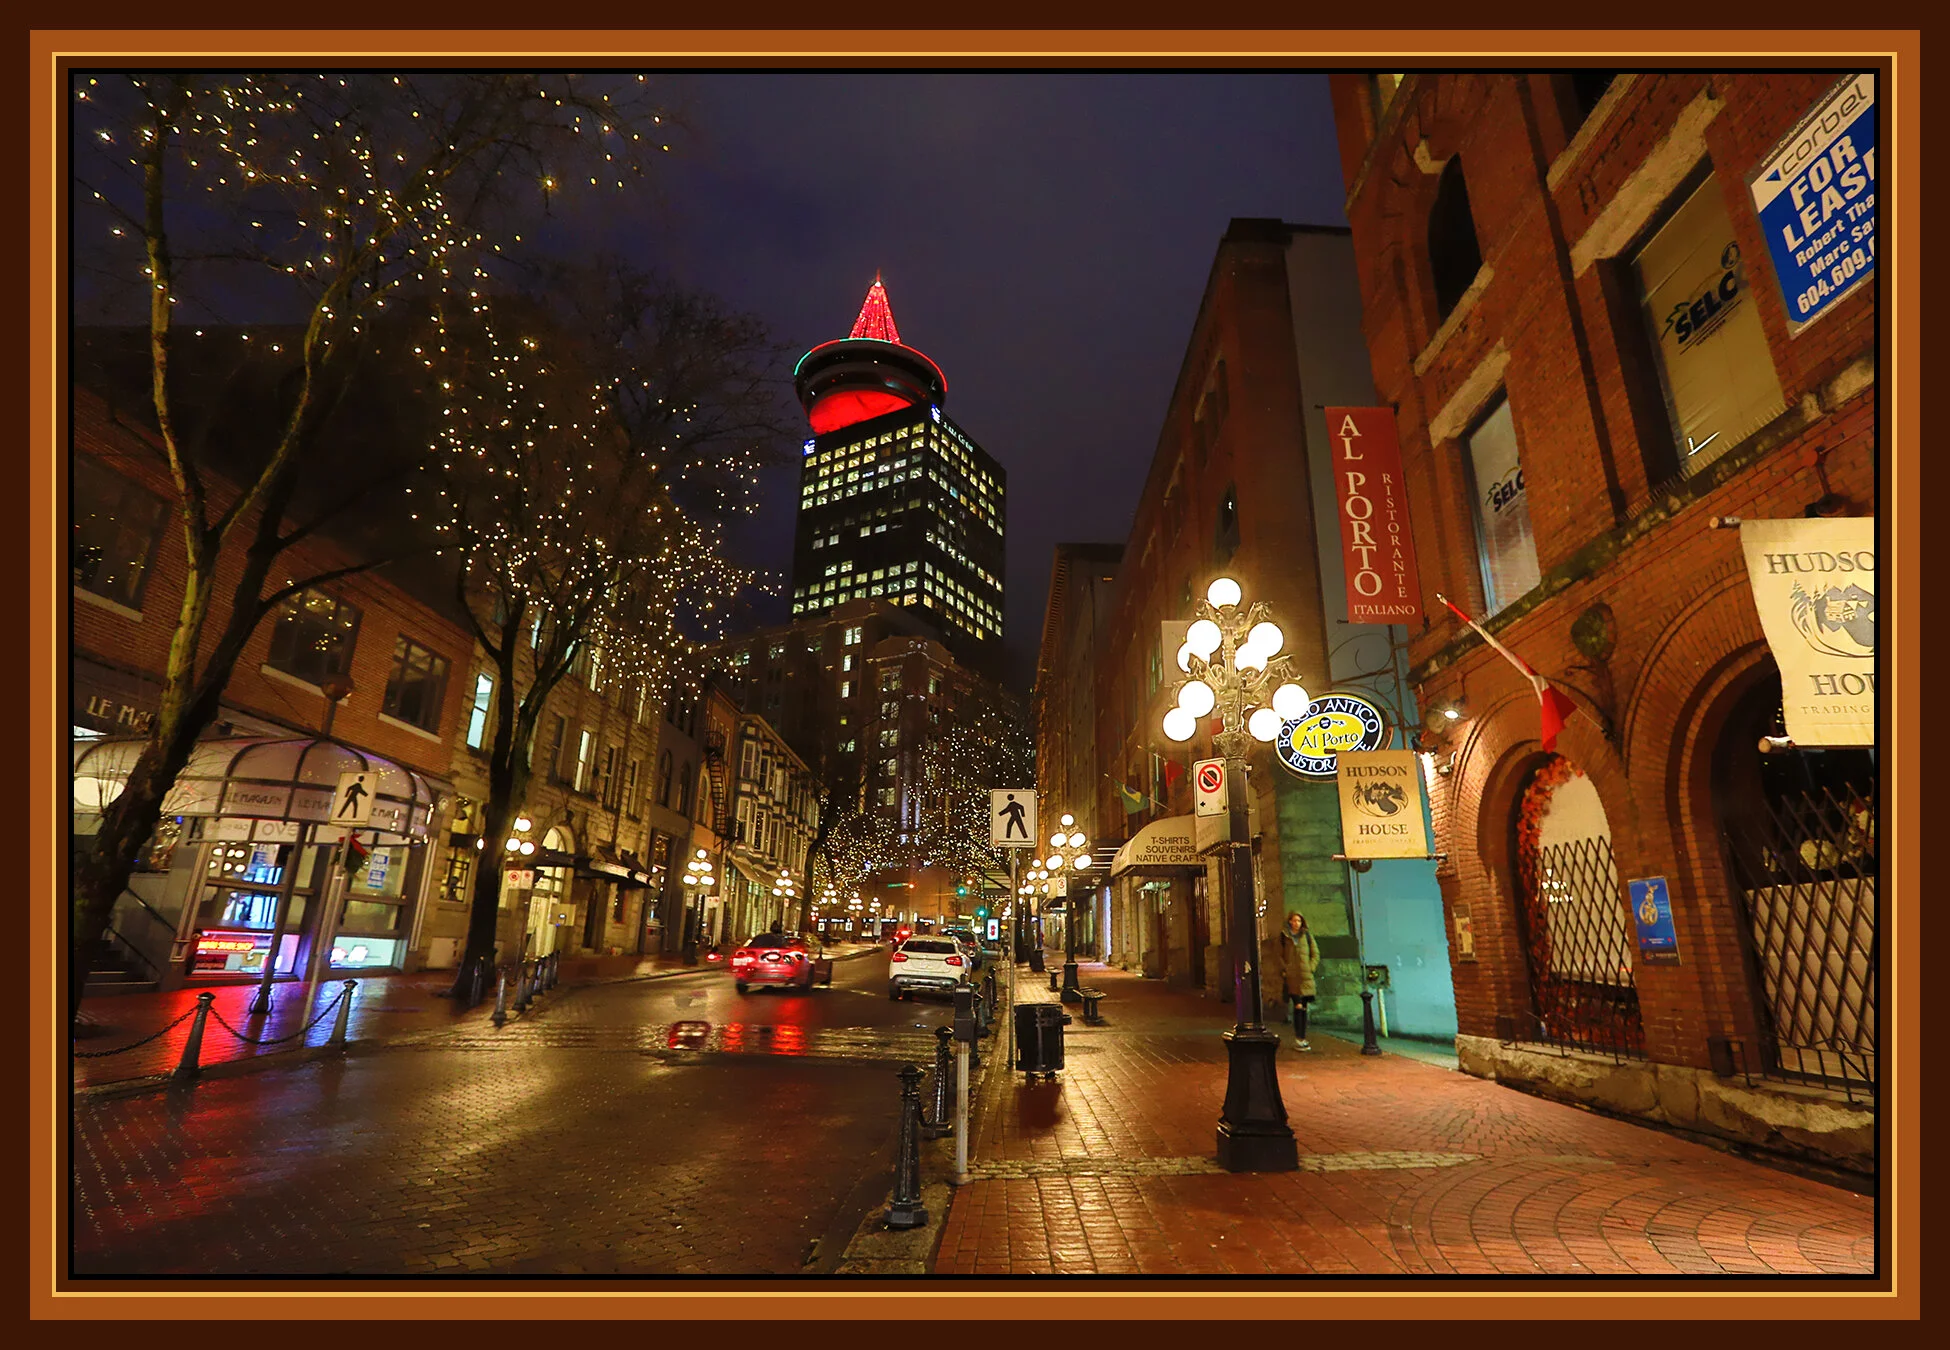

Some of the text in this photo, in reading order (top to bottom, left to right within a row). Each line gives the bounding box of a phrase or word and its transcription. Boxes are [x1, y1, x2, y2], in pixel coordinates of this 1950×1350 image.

[1782, 83, 1867, 175] corbel
[1789, 135, 1858, 211] FOR
[1795, 219, 1846, 267] Robert
[1809, 240, 1850, 278] Marc
[1337, 414, 1383, 596] AL PORTO
[1382, 473, 1408, 598] RISTORANTE
[1354, 604, 1416, 616] ITALIANO
[87, 695, 113, 719] LE
[1323, 698, 1379, 733] ANTICO
[1801, 704, 1871, 715] TRADING
[1299, 732, 1359, 751] Al Porto
[1345, 765, 1408, 777] HUDSON
[1359, 823, 1409, 835] HOUSE
[1145, 845, 1197, 854] SOUVENIRS
[1151, 836, 1190, 845] T-SHIRTS
[1136, 854, 1206, 863] NATIVE CRAFTS
